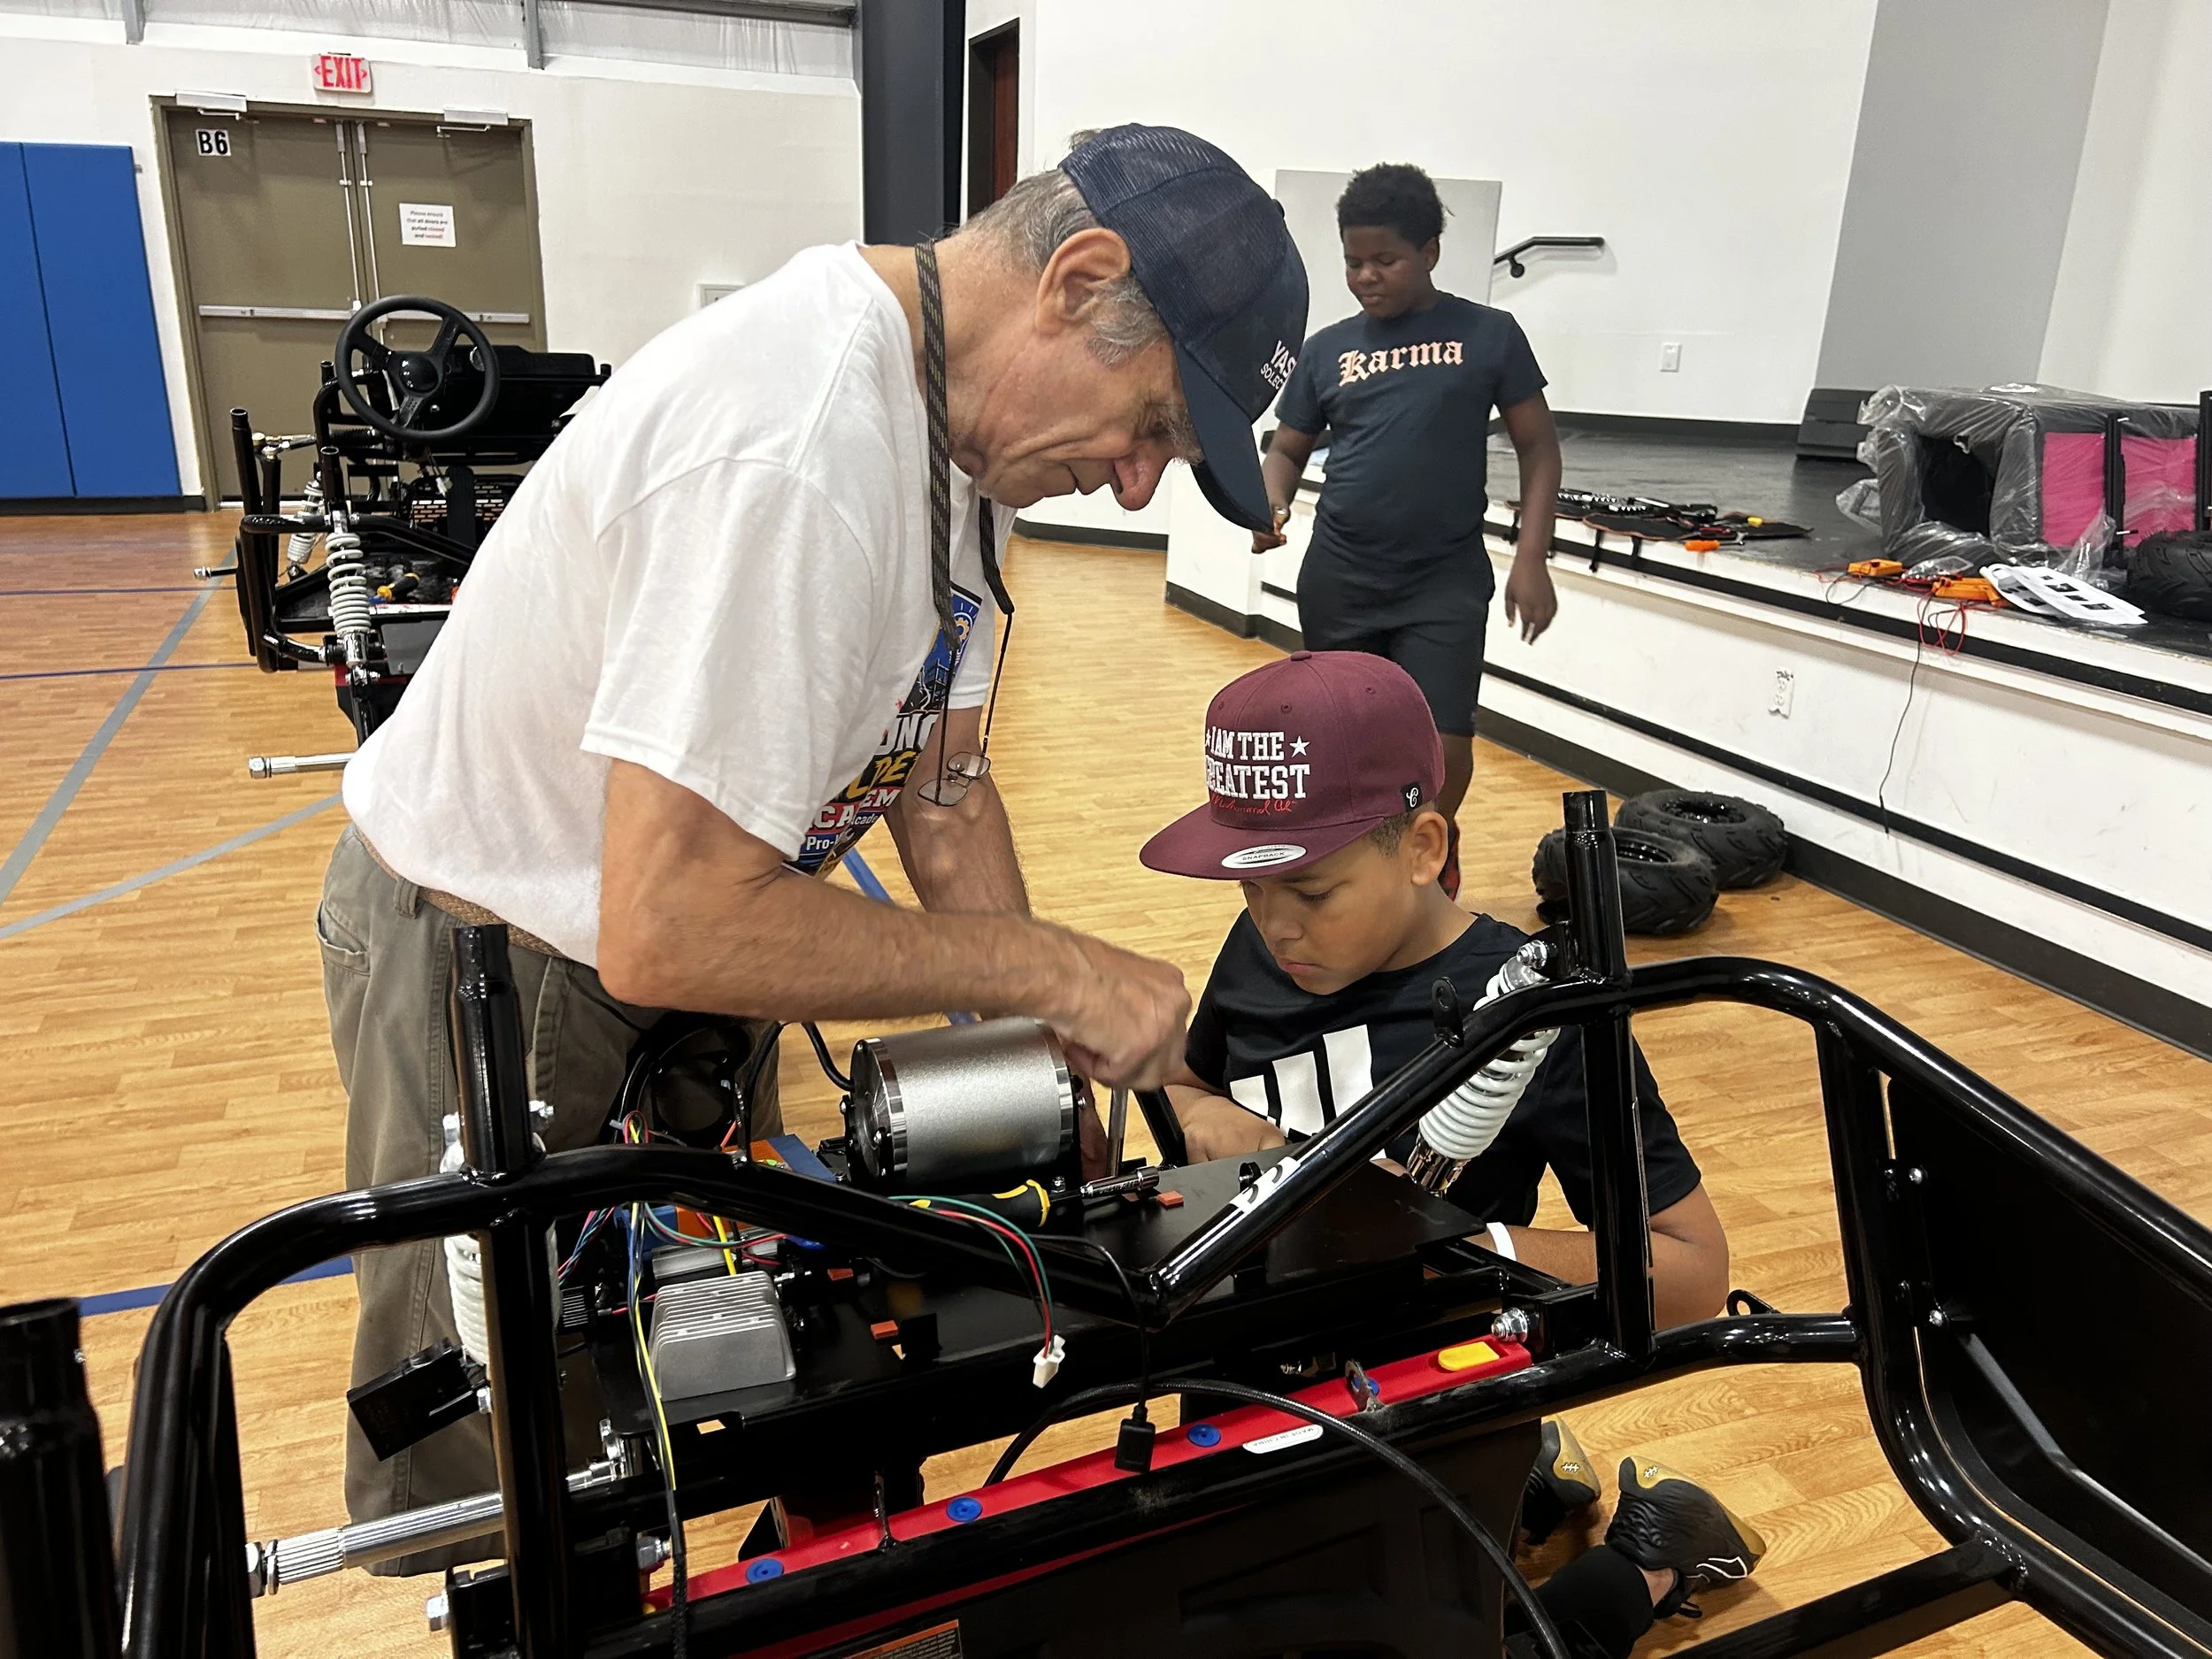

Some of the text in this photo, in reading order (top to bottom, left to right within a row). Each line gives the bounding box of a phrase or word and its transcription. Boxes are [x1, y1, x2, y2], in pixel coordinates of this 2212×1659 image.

[320, 56, 362, 90] EXIT
[198, 131, 227, 155] B6
[1338, 341, 1463, 387] Karma
[1214, 728, 1235, 759] AM
[1238, 732, 1285, 761] THE
[1242, 851, 1285, 861] SNAPBACK
